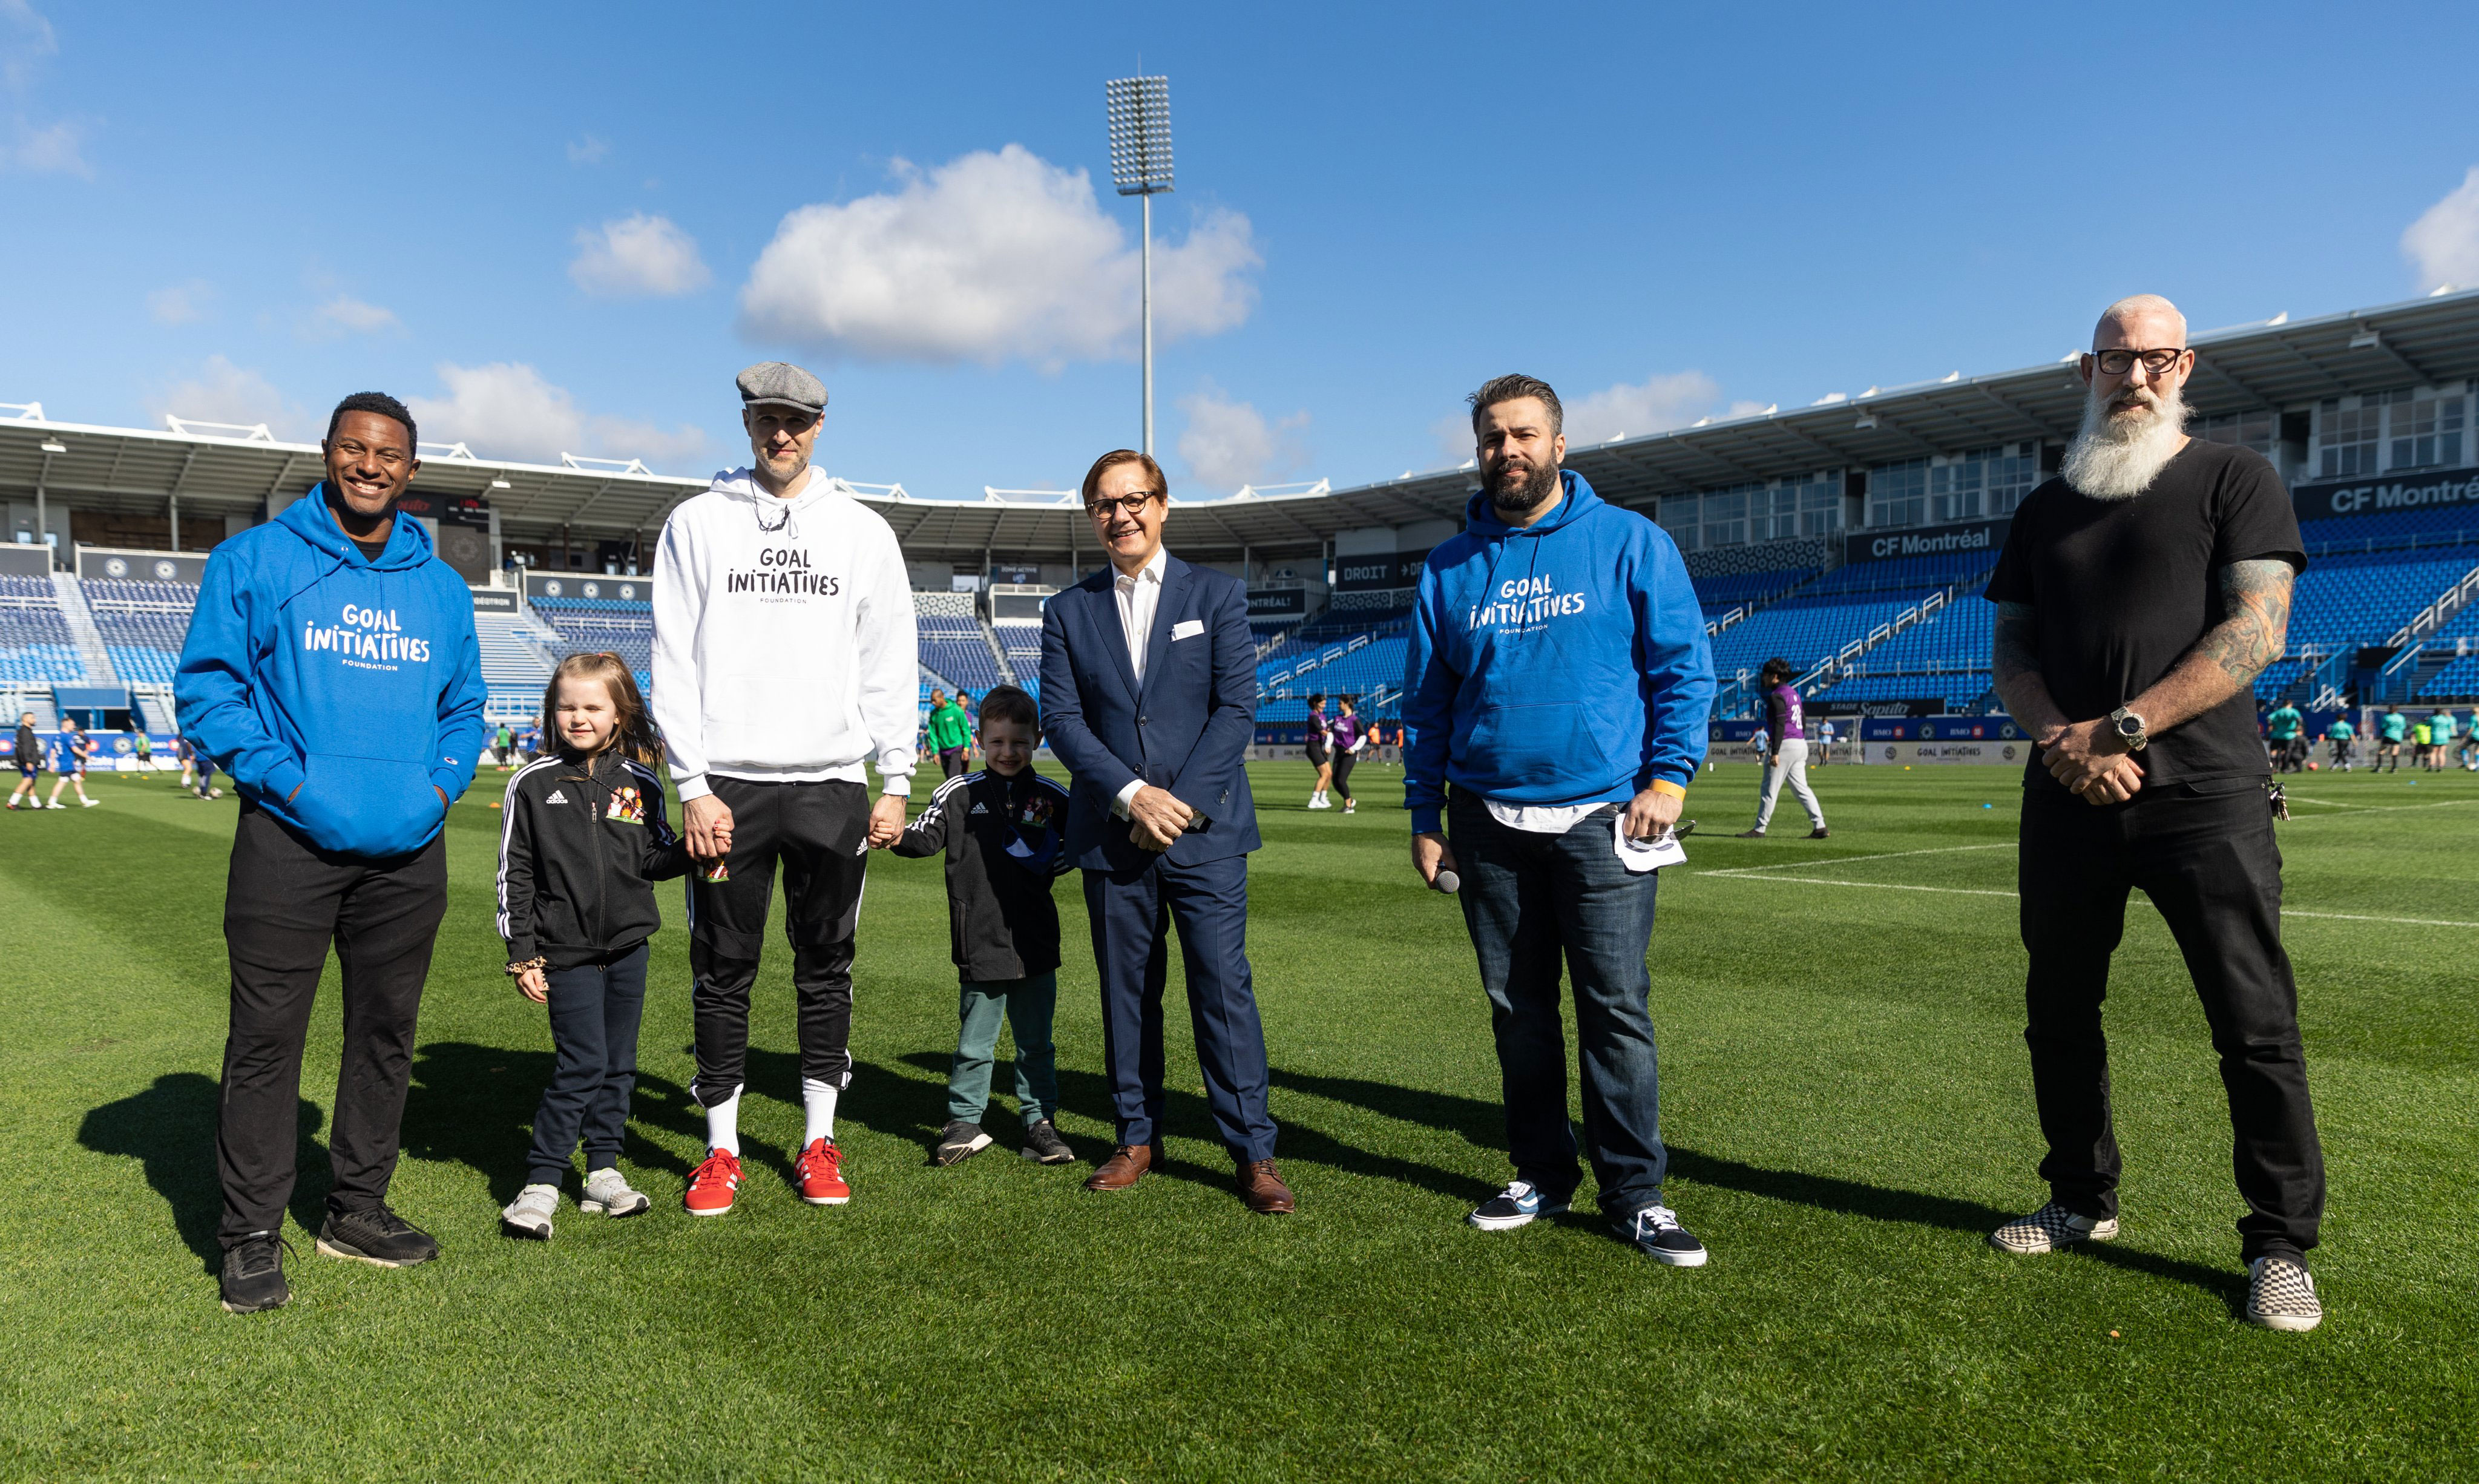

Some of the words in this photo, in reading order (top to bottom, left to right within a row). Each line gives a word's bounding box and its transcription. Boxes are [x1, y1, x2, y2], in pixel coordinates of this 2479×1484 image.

[2331, 487, 2373, 513] CF
[2376, 475, 2479, 508] Montré
[1872, 537, 1899, 557] CF
[1902, 527, 1990, 555] Montréal
[760, 548, 811, 569] GOAL
[1344, 565, 1387, 581] DROIT
[1501, 574, 1552, 599] GOAL
[343, 604, 401, 632] GOAL
[343, 659, 398, 671] FOUNDATION
[1917, 747, 1936, 757] GOAL
